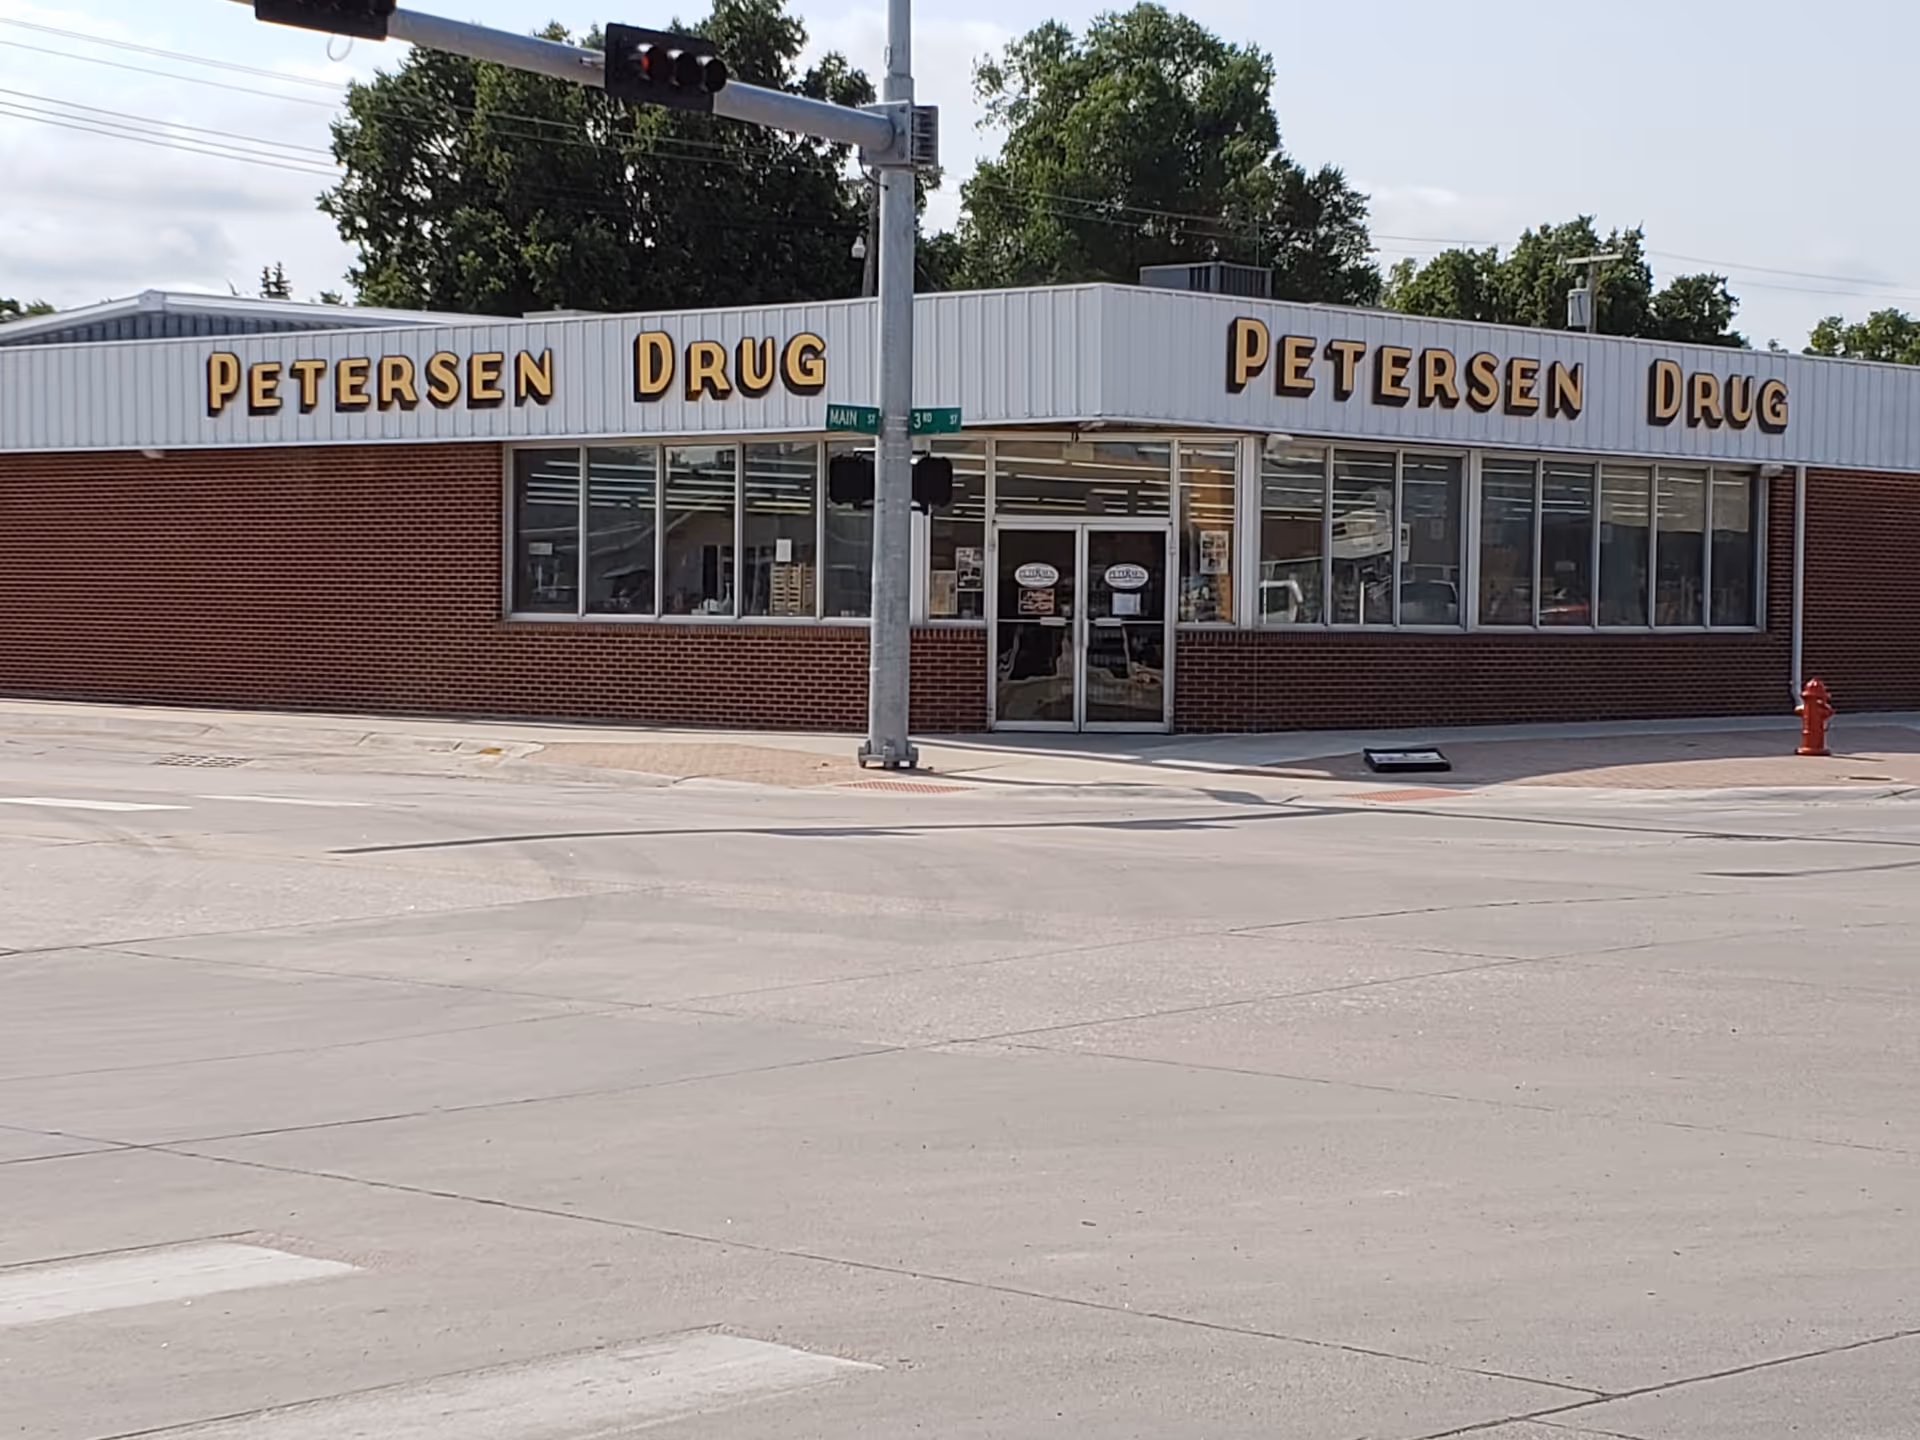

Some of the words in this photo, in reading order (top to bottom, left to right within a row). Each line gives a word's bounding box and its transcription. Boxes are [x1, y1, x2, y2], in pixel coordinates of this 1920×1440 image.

[206, 350, 553, 418] PETERSEN
[633, 330, 826, 402] DRUG
[1227, 317, 1583, 420] PETERSEN
[1648, 358, 1789, 434] DRUG
[829, 408, 858, 427] MAIN
[866, 413, 876, 425] ST
[913, 412, 932, 429] 3RD
[950, 413, 958, 425] ST
